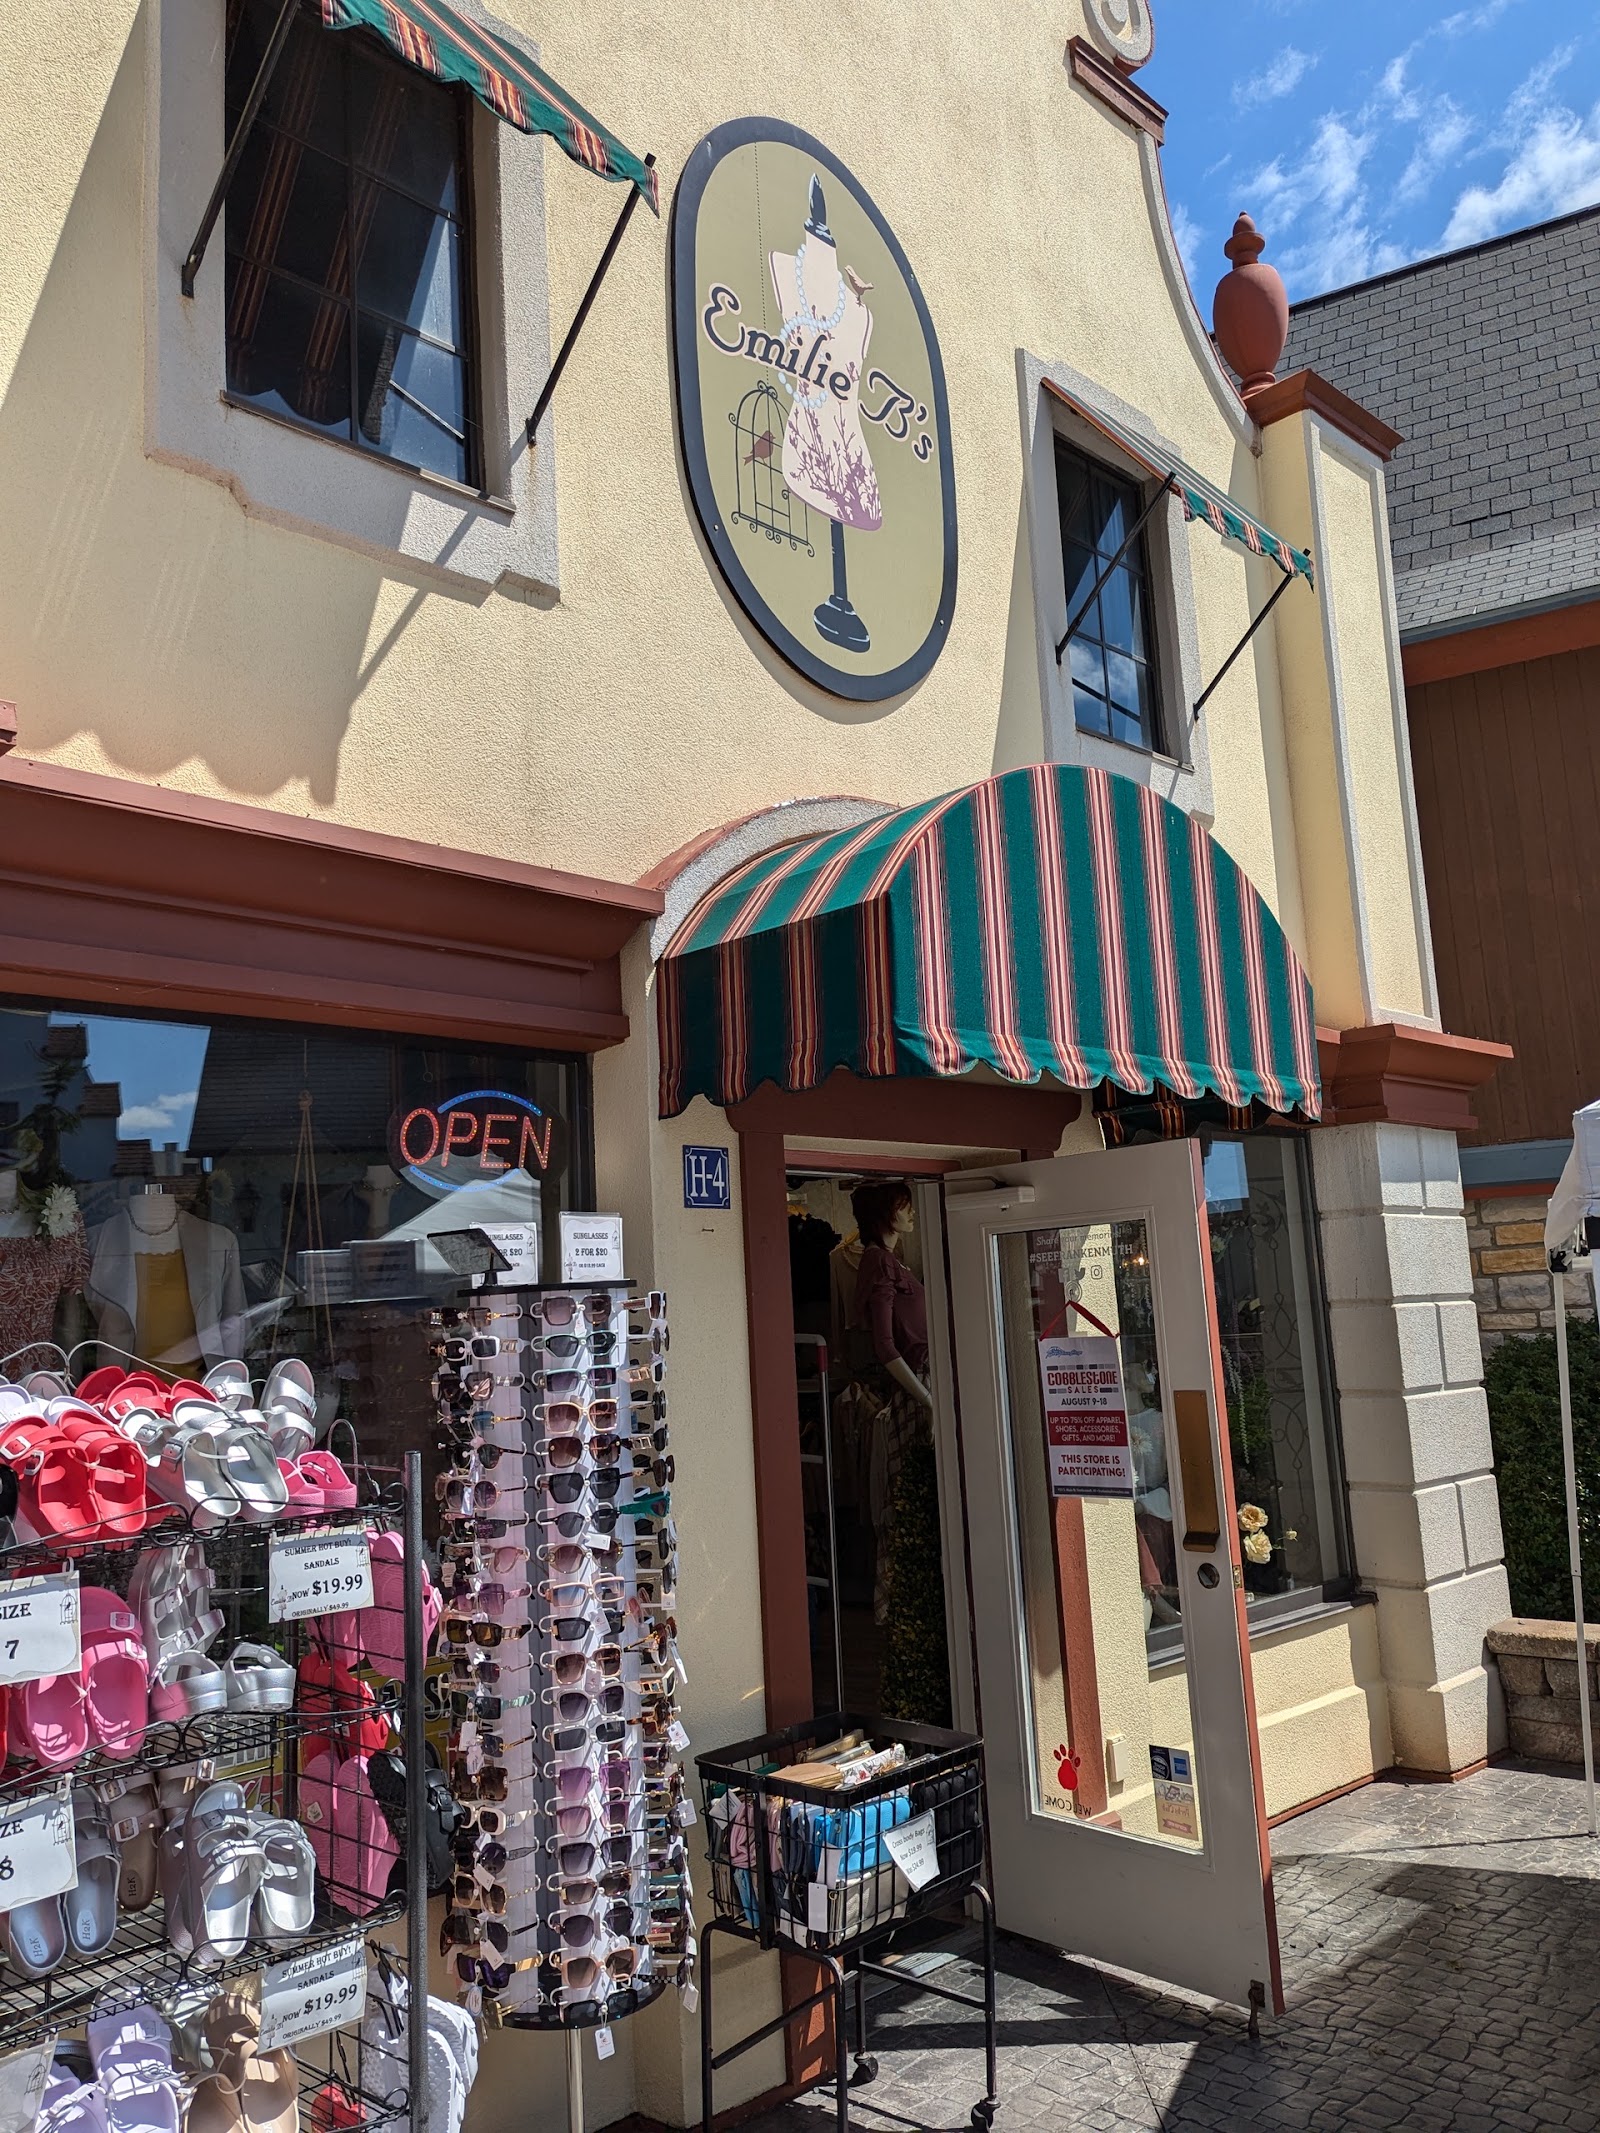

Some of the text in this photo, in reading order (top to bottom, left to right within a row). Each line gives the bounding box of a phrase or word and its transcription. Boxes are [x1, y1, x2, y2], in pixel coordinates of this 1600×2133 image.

[702, 283, 932, 463] Emilie B's
[400, 1107, 552, 1170] OPEN
[689, 1155, 725, 1199] H-4
[1036, 1236, 1059, 1246] Share
[509, 1248, 523, 1256] $20
[575, 1247, 608, 1256] 2 FOR $20
[1067, 1385, 1099, 1394] SALES
[1061, 1397, 1108, 1406] AUGUST 9-18
[1049, 1416, 1059, 1424] UP
[1060, 1416, 1069, 1424] TO
[1083, 1416, 1095, 1424] OFF
[1096, 1434, 1116, 1442] MORE!
[1061, 1454, 1121, 1465] THIS STORE IS
[1058, 1466, 1126, 1477] PARTICIPATING!
[284, 1545, 317, 1557] SUMMER
[318, 1542, 333, 1552] HOT
[304, 1557, 340, 1570] SANDALS
[292, 1588, 310, 1600] NOW
[312, 1573, 363, 1597] $19.99
[291, 1601, 349, 1618] ORIGINALLY $49.99
[5, 1639, 20, 1660] 7
[127, 1876, 137, 1896] H2K
[82, 1919, 91, 1940] H2K
[29, 1937, 43, 1957] H2K
[282, 1960, 315, 1978] SUMMER
[316, 1953, 331, 1966] HOT
[297, 1970, 335, 1991] SANDALS
[282, 1983, 358, 2023] NOW $19.99
[282, 2020, 320, 2040] ORIGINALLY
